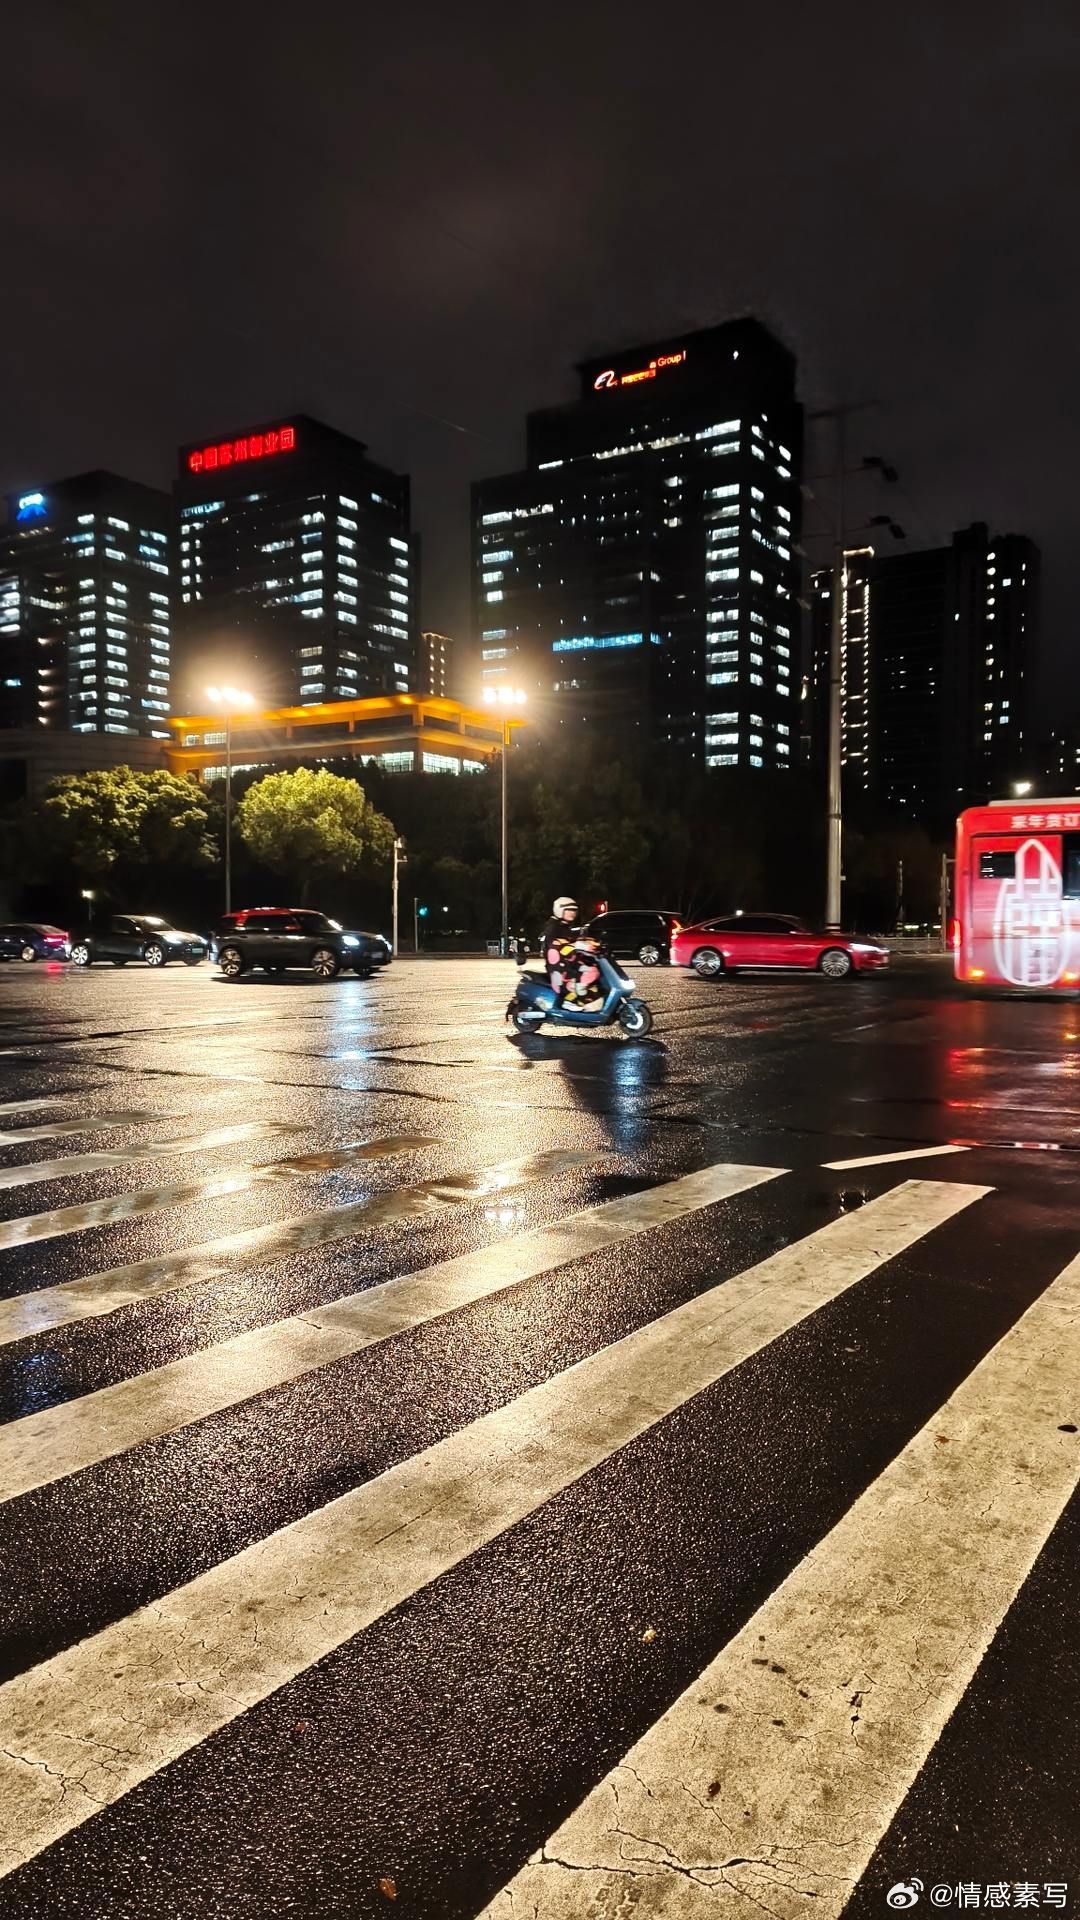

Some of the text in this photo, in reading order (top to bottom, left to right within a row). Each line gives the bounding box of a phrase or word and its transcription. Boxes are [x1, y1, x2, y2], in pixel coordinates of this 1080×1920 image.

[189, 428, 295, 472] 中国苏州创业园
